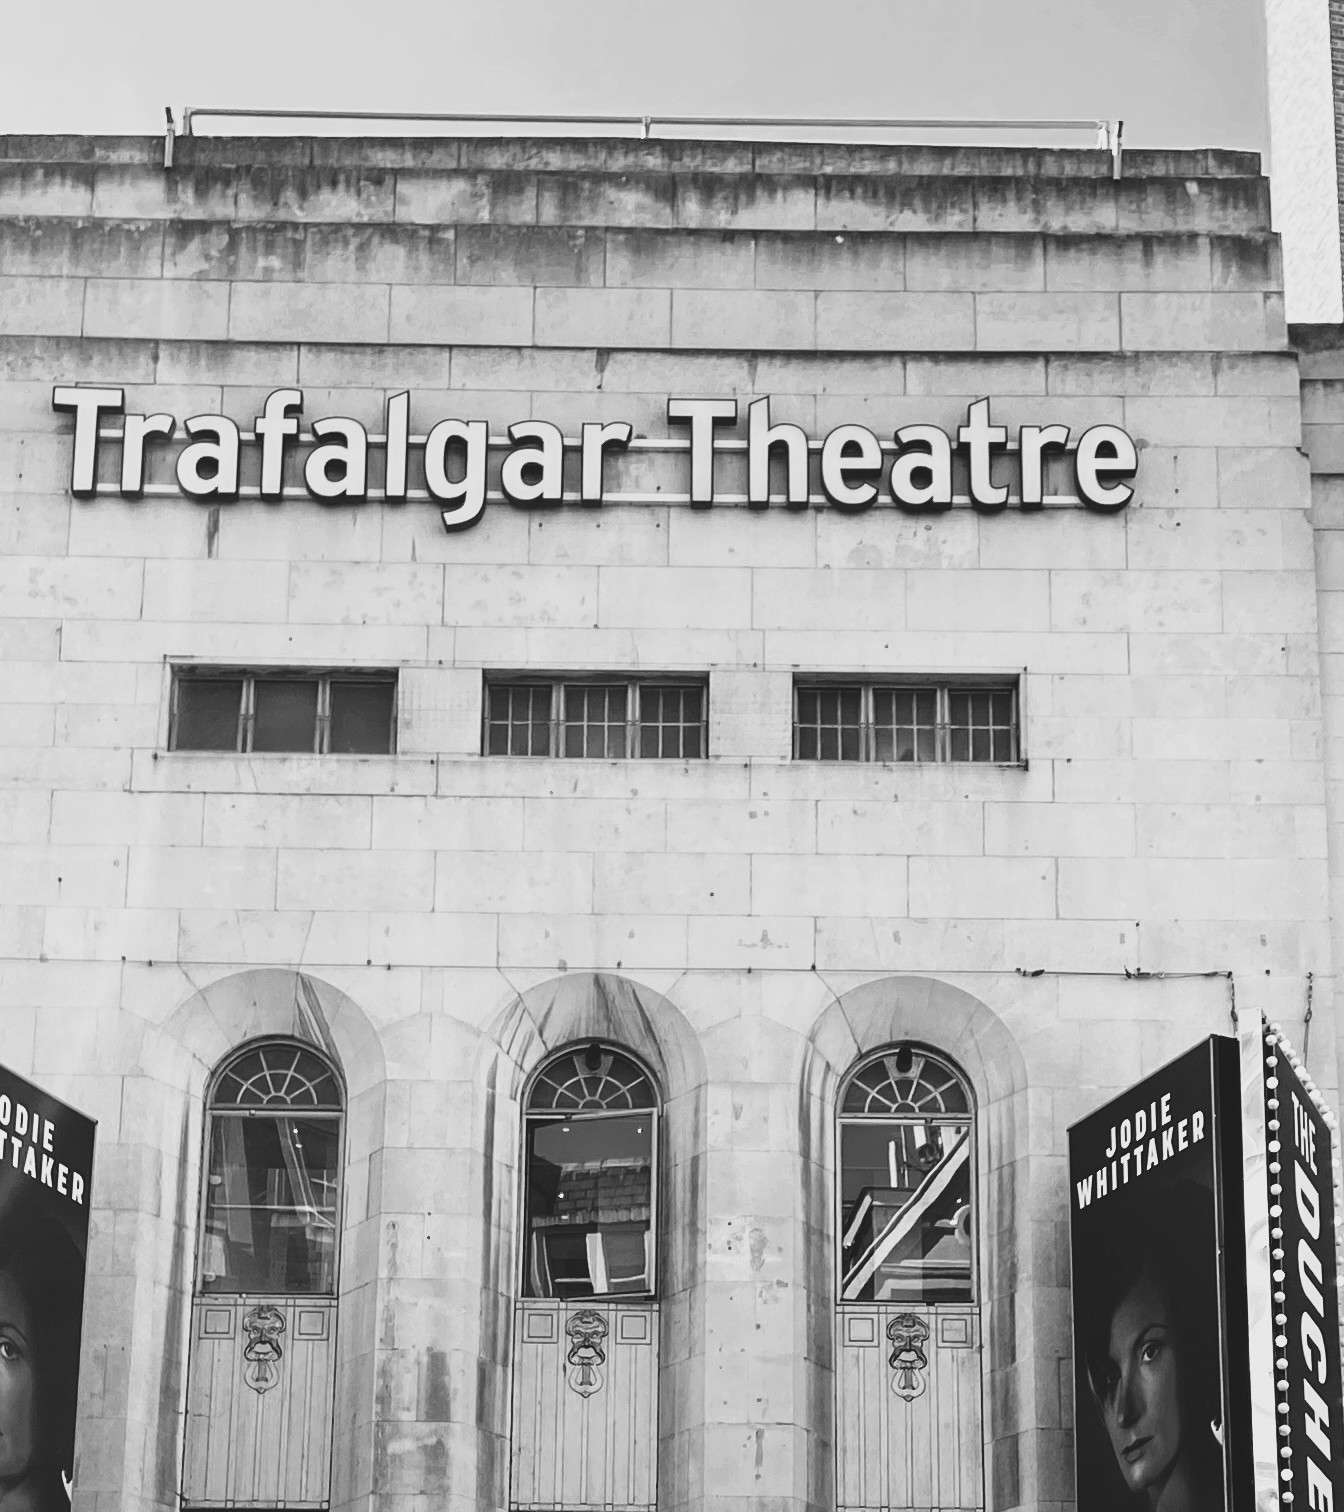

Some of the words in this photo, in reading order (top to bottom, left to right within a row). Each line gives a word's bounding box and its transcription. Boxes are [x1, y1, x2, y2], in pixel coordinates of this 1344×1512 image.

[53, 386, 632, 533] Trafalgar
[667, 394, 1140, 514] Theatre
[1076, 1110, 1206, 1209] WHITTAKER
[1105, 1093, 1172, 1159] JODIE
[1291, 1090, 1318, 1175] THE
